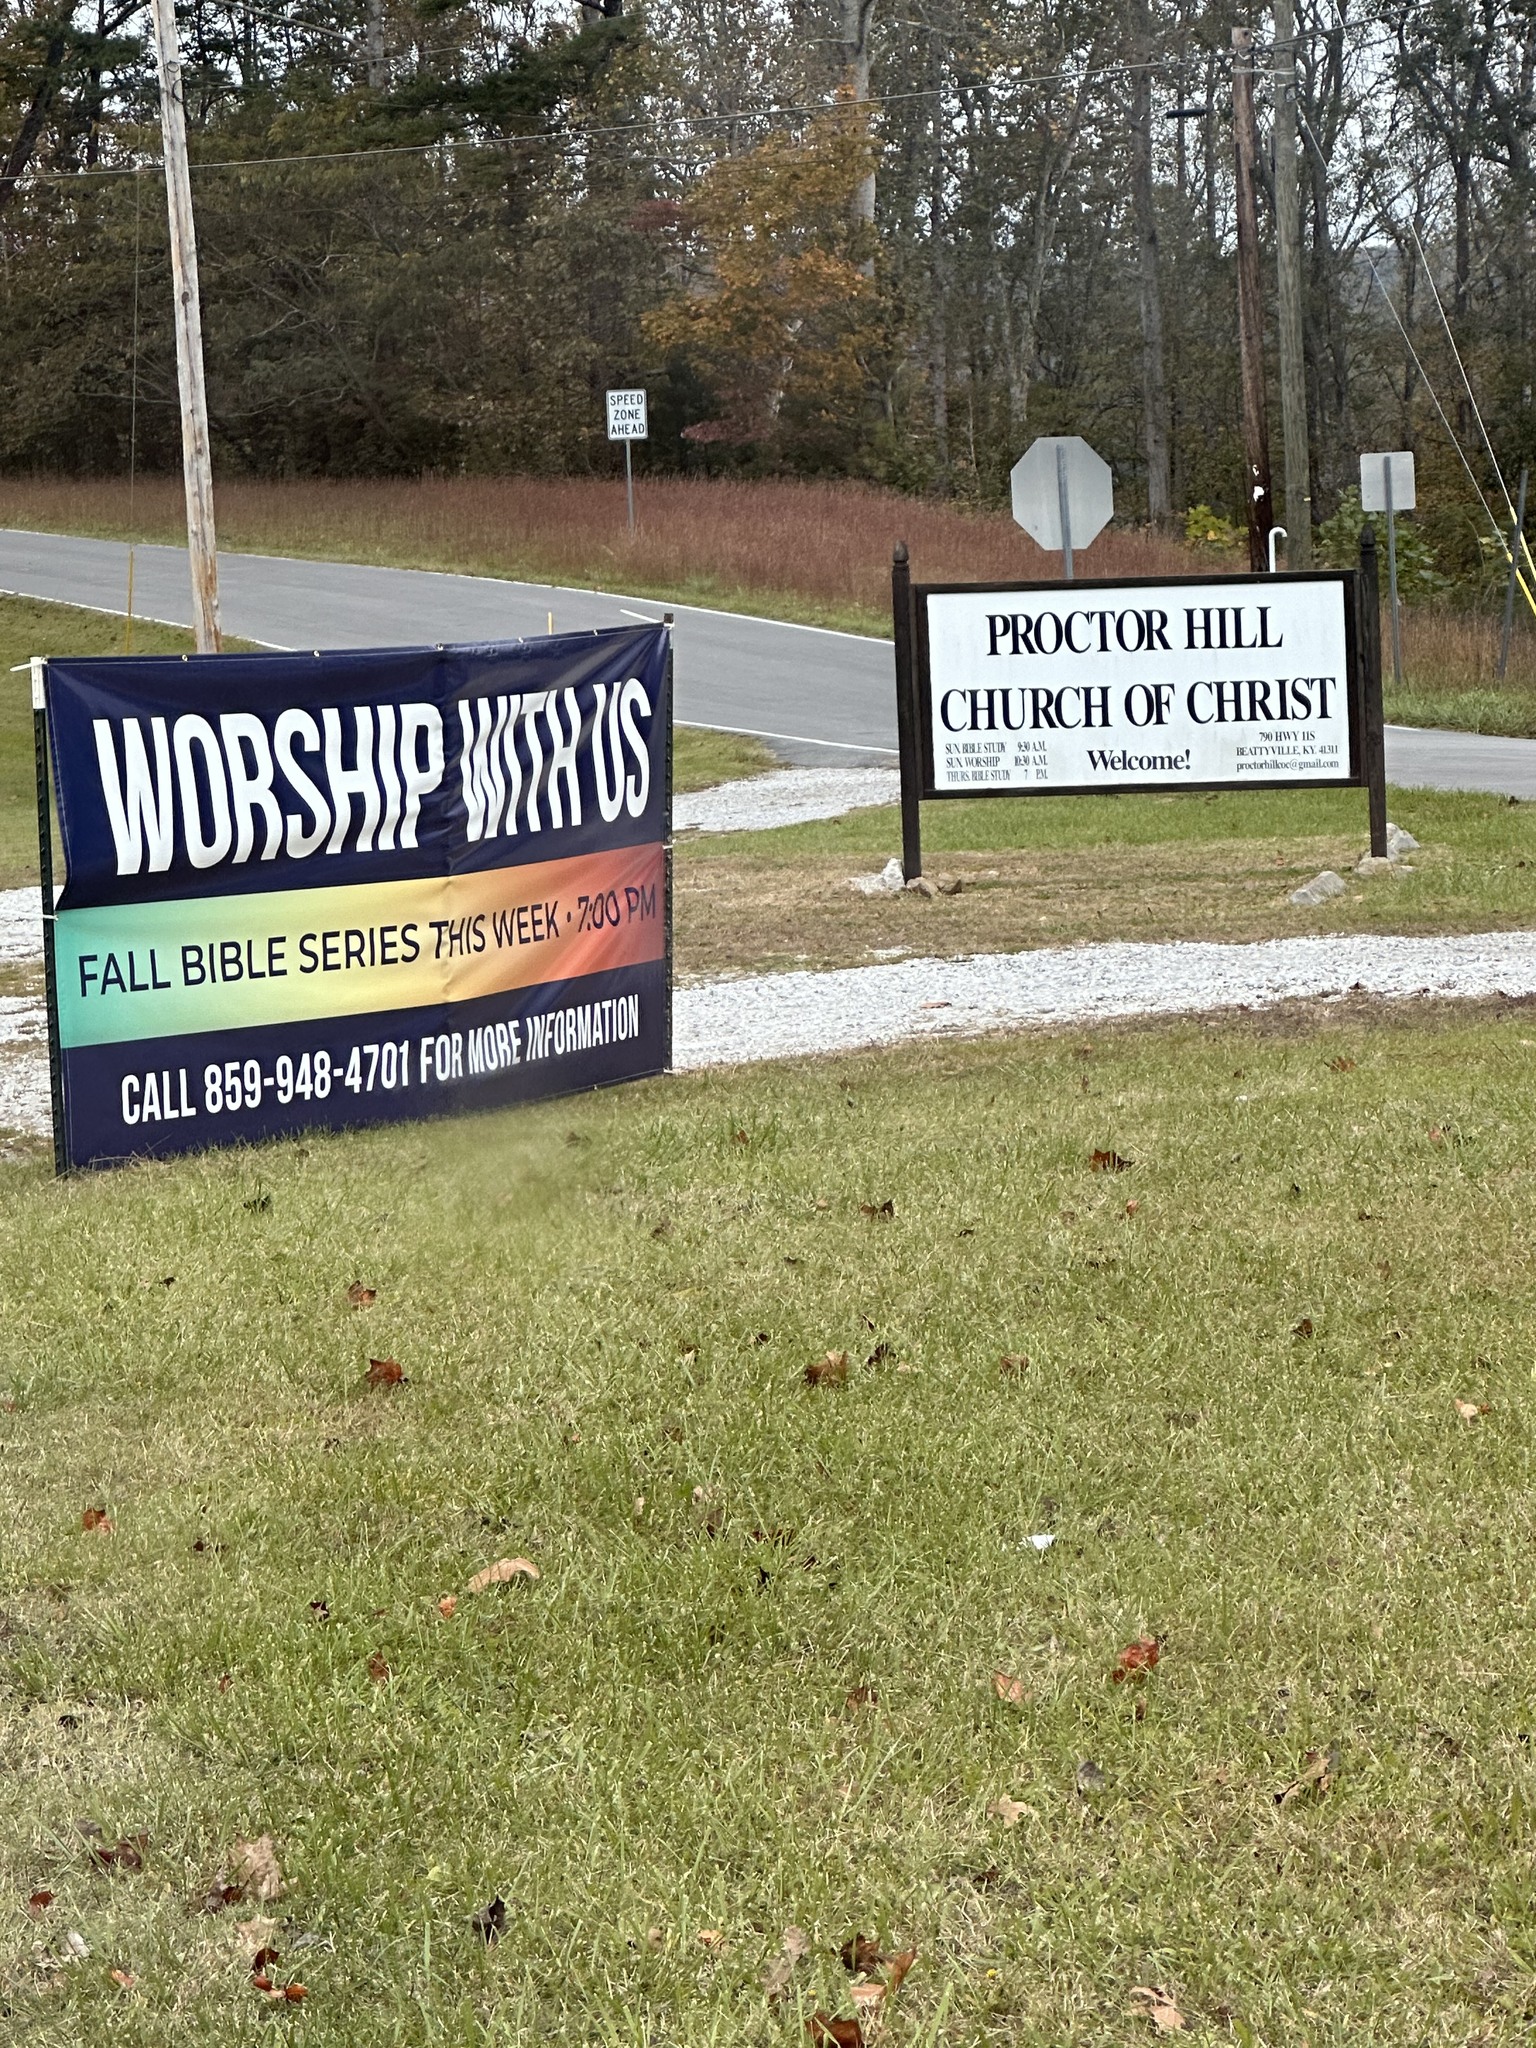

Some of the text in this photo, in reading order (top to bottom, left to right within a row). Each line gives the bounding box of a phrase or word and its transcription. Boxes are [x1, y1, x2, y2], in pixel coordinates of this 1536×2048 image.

[610, 394, 643, 406] SPEED
[614, 409, 640, 420] ZONE
[611, 423, 644, 435] AHEAD
[985, 606, 1284, 656] PROCTOR HILL
[940, 677, 1337, 732] CHURCH OF CHRIST
[1259, 732, 1273, 742] 790
[1275, 731, 1299, 741] HWY
[962, 743, 982, 753] BIBLE
[984, 742, 1006, 753] STUDY
[1017, 741, 1030, 752] 9:30
[1236, 745, 1301, 756] BEATTYVILLE,
[1319, 745, 1338, 754] 41311
[965, 756, 1000, 767] WORSHIP
[1014, 755, 1030, 766] 10:30
[1087, 748, 1191, 771] Welcome!
[93, 677, 652, 876] WORSHIP WITH US
[971, 770, 989, 781] BIBLE
[991, 769, 1011, 781] STUDY
[1024, 769, 1028, 780] 7
[79, 887, 656, 998] FALL BIBLE SERIES THIS WEEK 7:00 PM
[121, 994, 640, 1125] CALL 859-948-4701 FOR MORE INFORMATION
